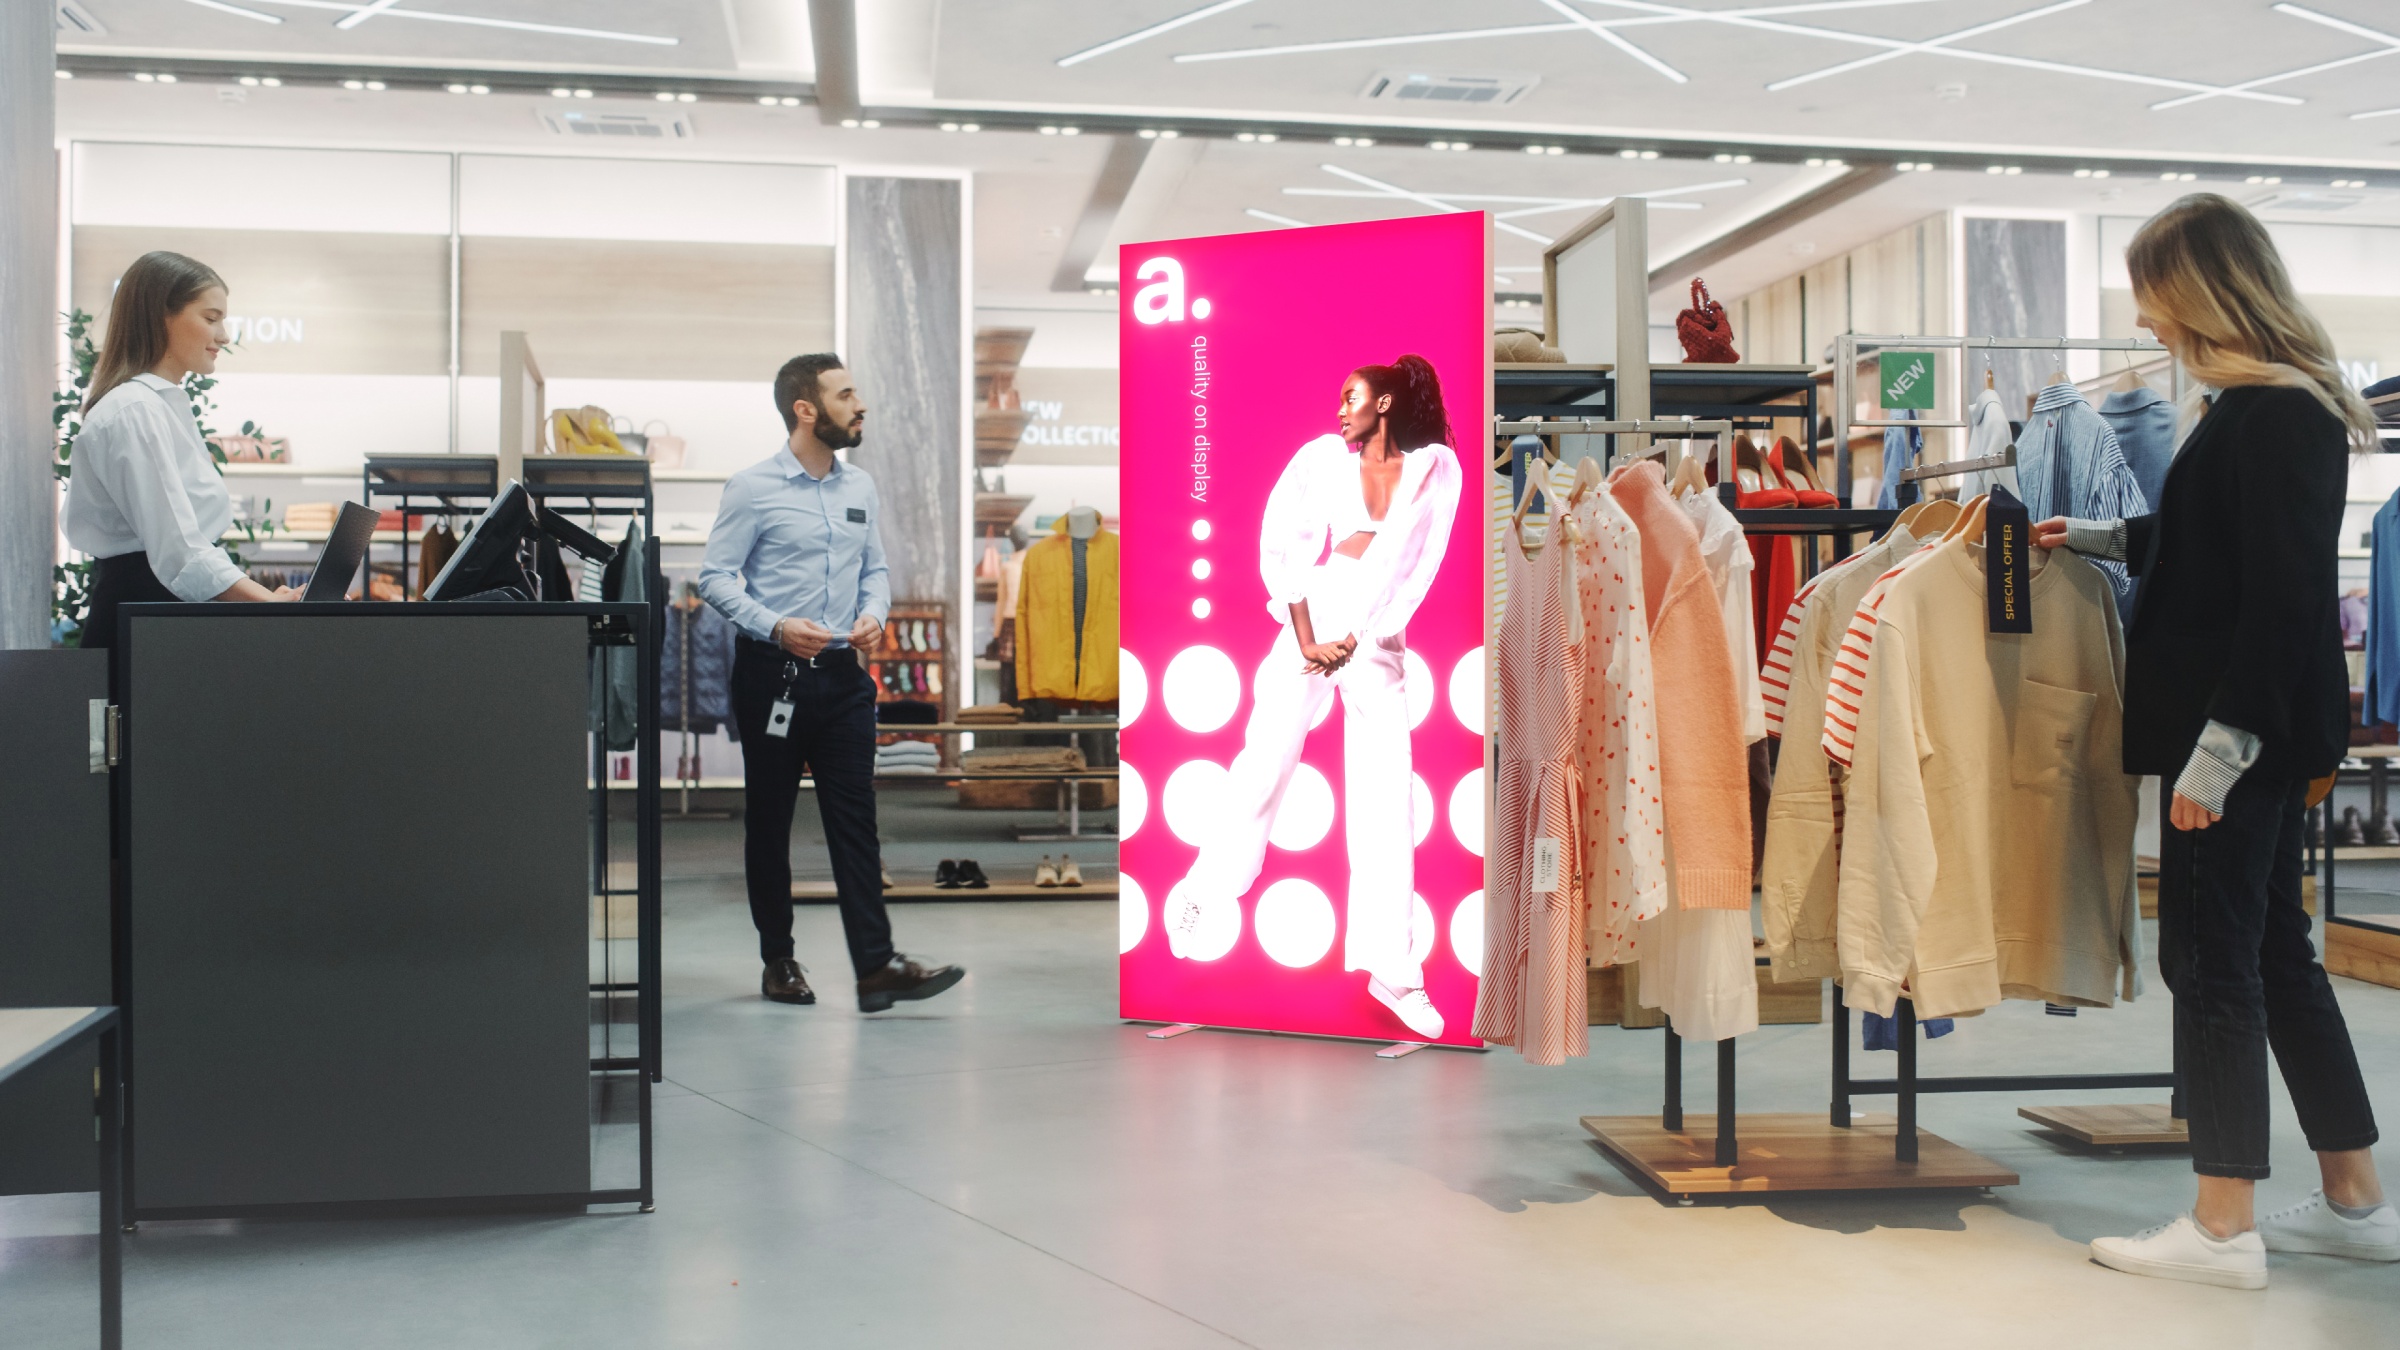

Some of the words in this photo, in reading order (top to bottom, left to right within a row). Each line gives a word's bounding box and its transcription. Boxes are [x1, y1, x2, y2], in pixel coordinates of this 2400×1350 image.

[1191, 335, 1211, 400] quality
[1886, 358, 1926, 401] NEW
[1021, 400, 1063, 421] EW
[1194, 404, 1208, 429] on
[1191, 434, 1211, 503] display
[2003, 524, 2013, 565] OFFER
[2004, 567, 2015, 620] SPECIAL
